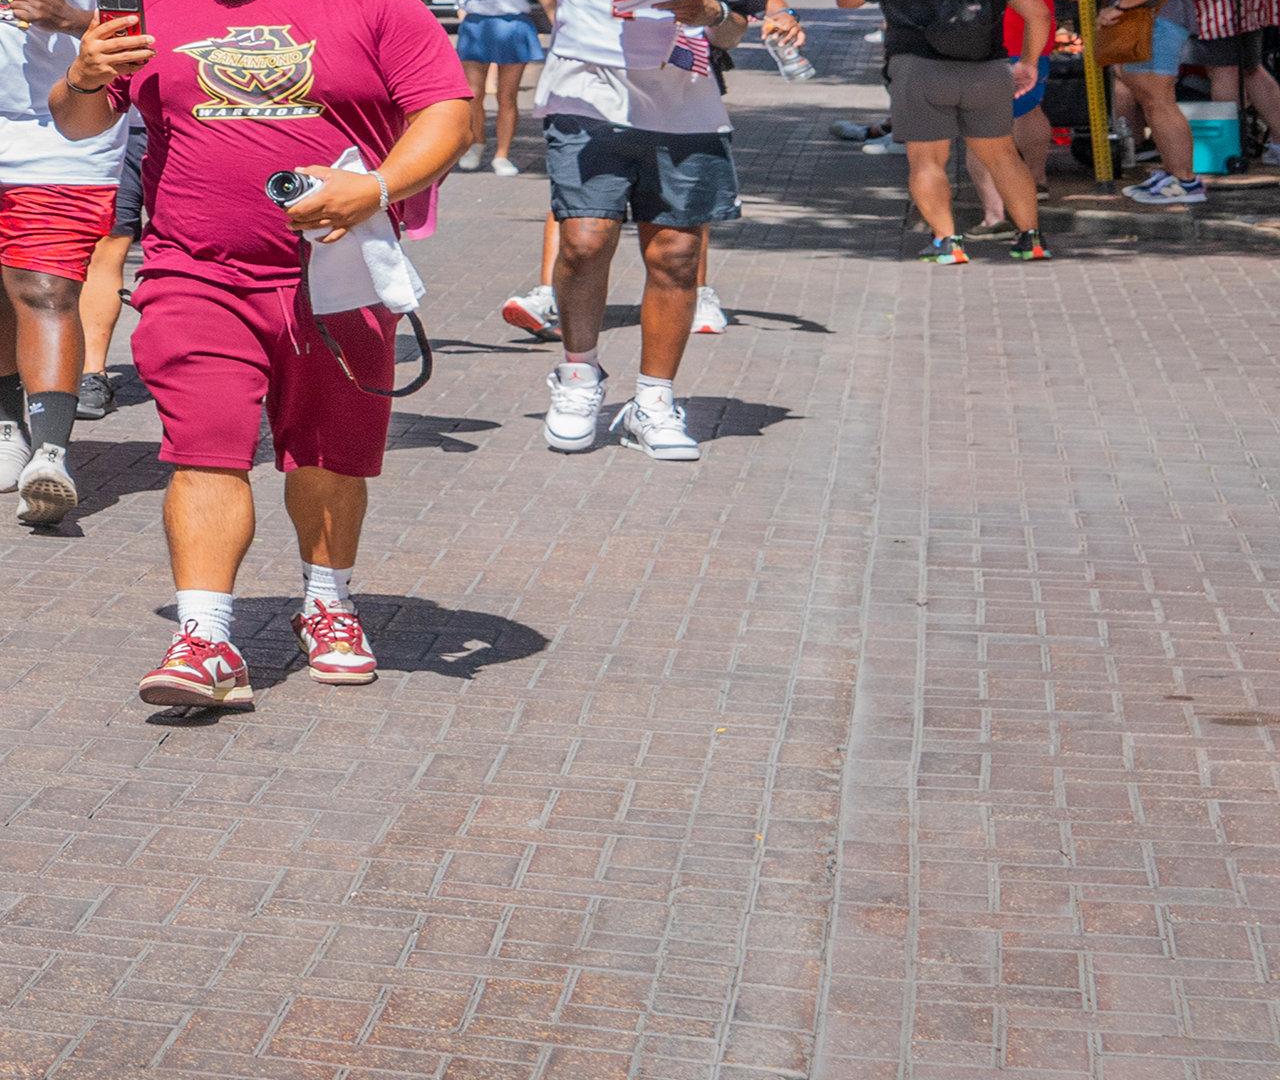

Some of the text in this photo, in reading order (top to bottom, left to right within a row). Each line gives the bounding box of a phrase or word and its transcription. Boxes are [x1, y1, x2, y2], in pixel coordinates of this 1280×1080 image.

[208, 49, 303, 68] SAN ANTONIO
[198, 106, 319, 117] WARRIORS
